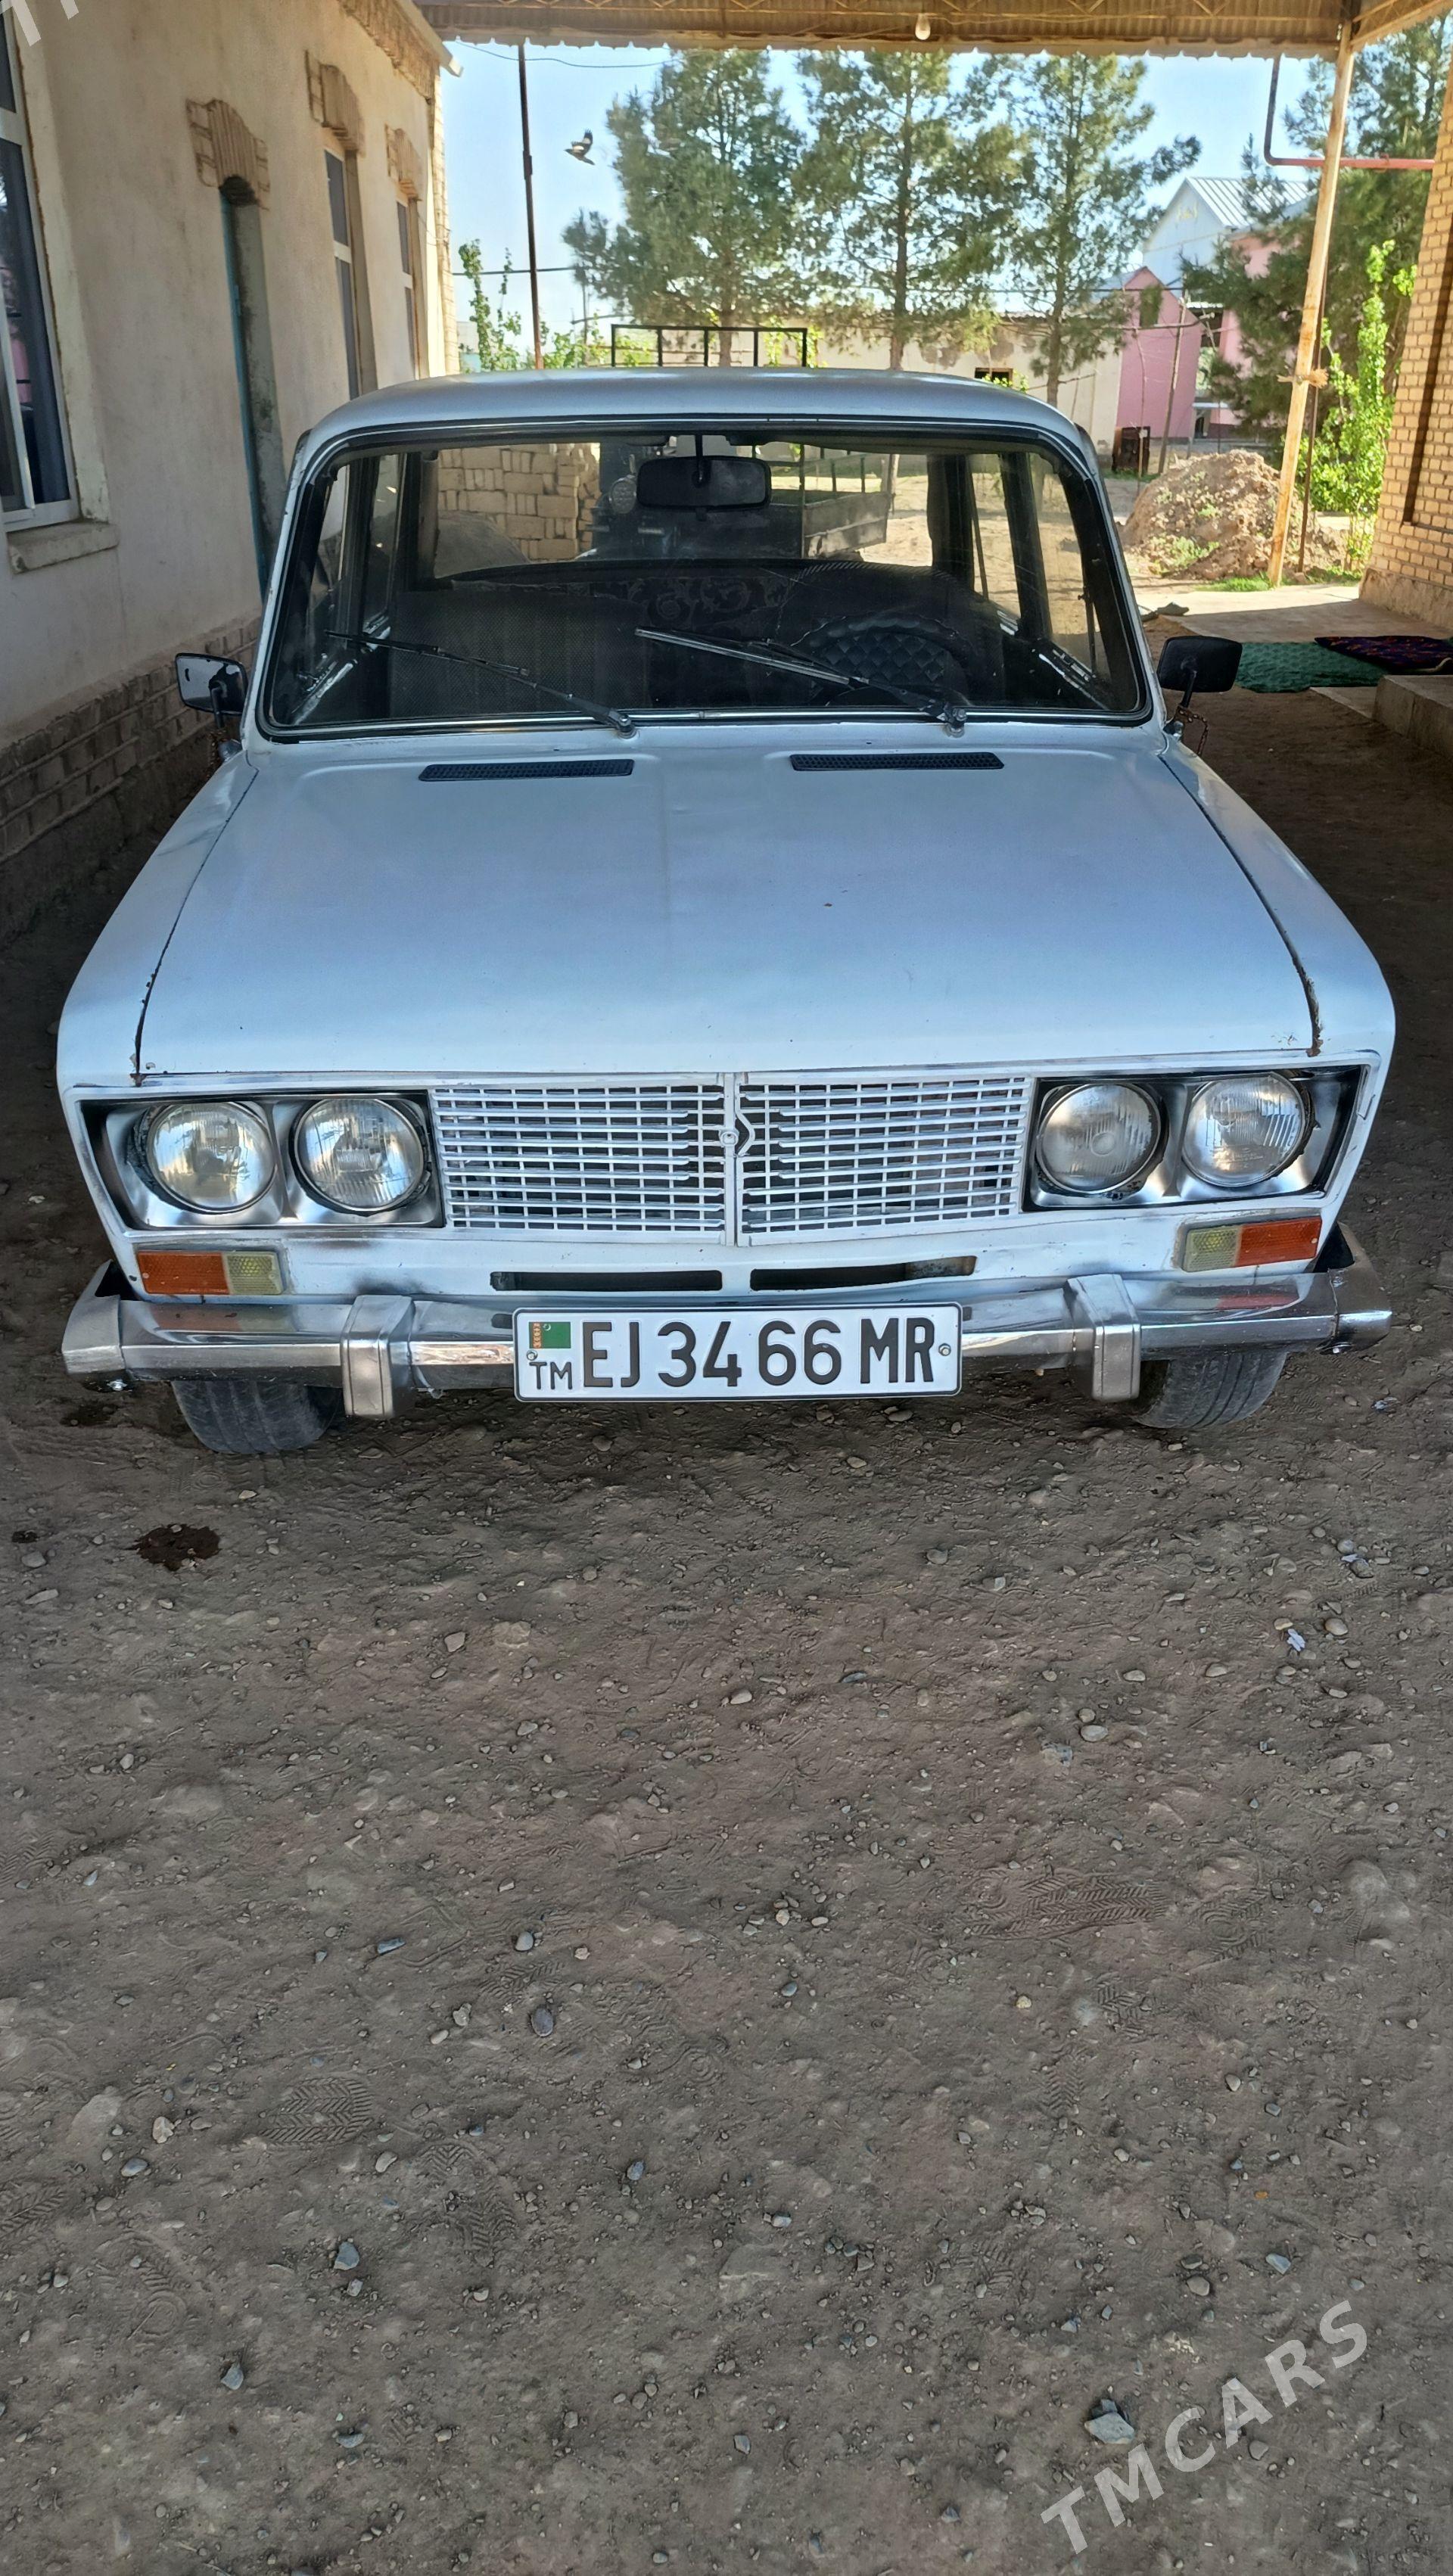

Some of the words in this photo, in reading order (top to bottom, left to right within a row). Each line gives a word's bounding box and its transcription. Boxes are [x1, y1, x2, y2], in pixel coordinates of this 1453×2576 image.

[529, 1361, 573, 1390] TM
[583, 1321, 641, 1388] EJ
[657, 1321, 742, 1388] 34
[758, 1319, 842, 1386] 66
[860, 1317, 935, 1384] MR
